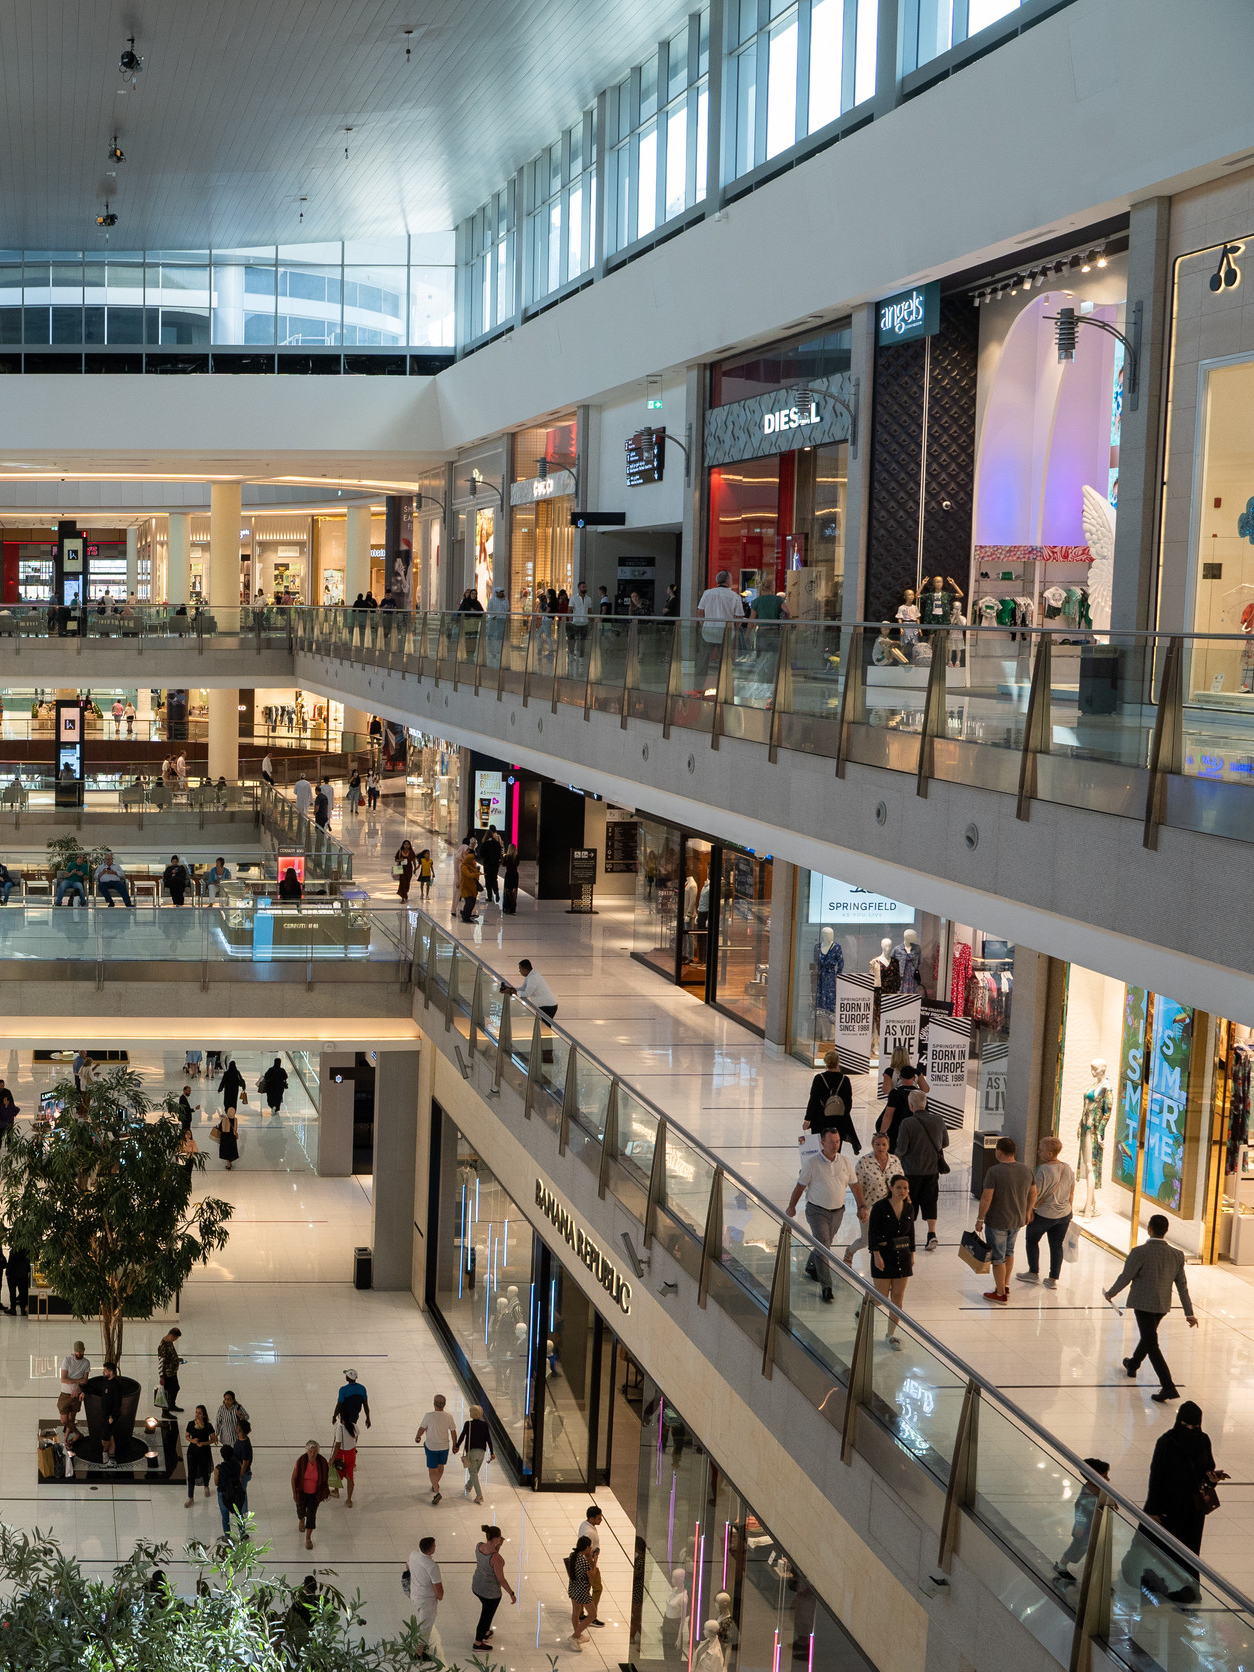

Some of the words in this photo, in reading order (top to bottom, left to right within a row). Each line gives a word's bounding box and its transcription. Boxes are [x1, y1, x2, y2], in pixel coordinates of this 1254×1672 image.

[881, 291, 923, 334] angels
[764, 402, 822, 435] DIESL
[828, 902, 897, 911] SPRINGFIELD
[840, 1003, 862, 1013] BORN
[863, 1003, 871, 1013] IN
[839, 1013, 870, 1024] EUROPE
[885, 1025, 897, 1036] AS
[899, 1025, 916, 1036] YOU
[884, 1037, 915, 1055] LIVE
[931, 1050, 956, 1061] BORN
[957, 1050, 966, 1061] IN
[931, 1062, 965, 1073] EUROPE
[930, 1074, 949, 1082] SINCE
[951, 1074, 965, 1082] 1988
[986, 1077, 1000, 1090] AS
[535, 1178, 578, 1252] BANANA
[577, 1228, 633, 1316] REPUBLIC
